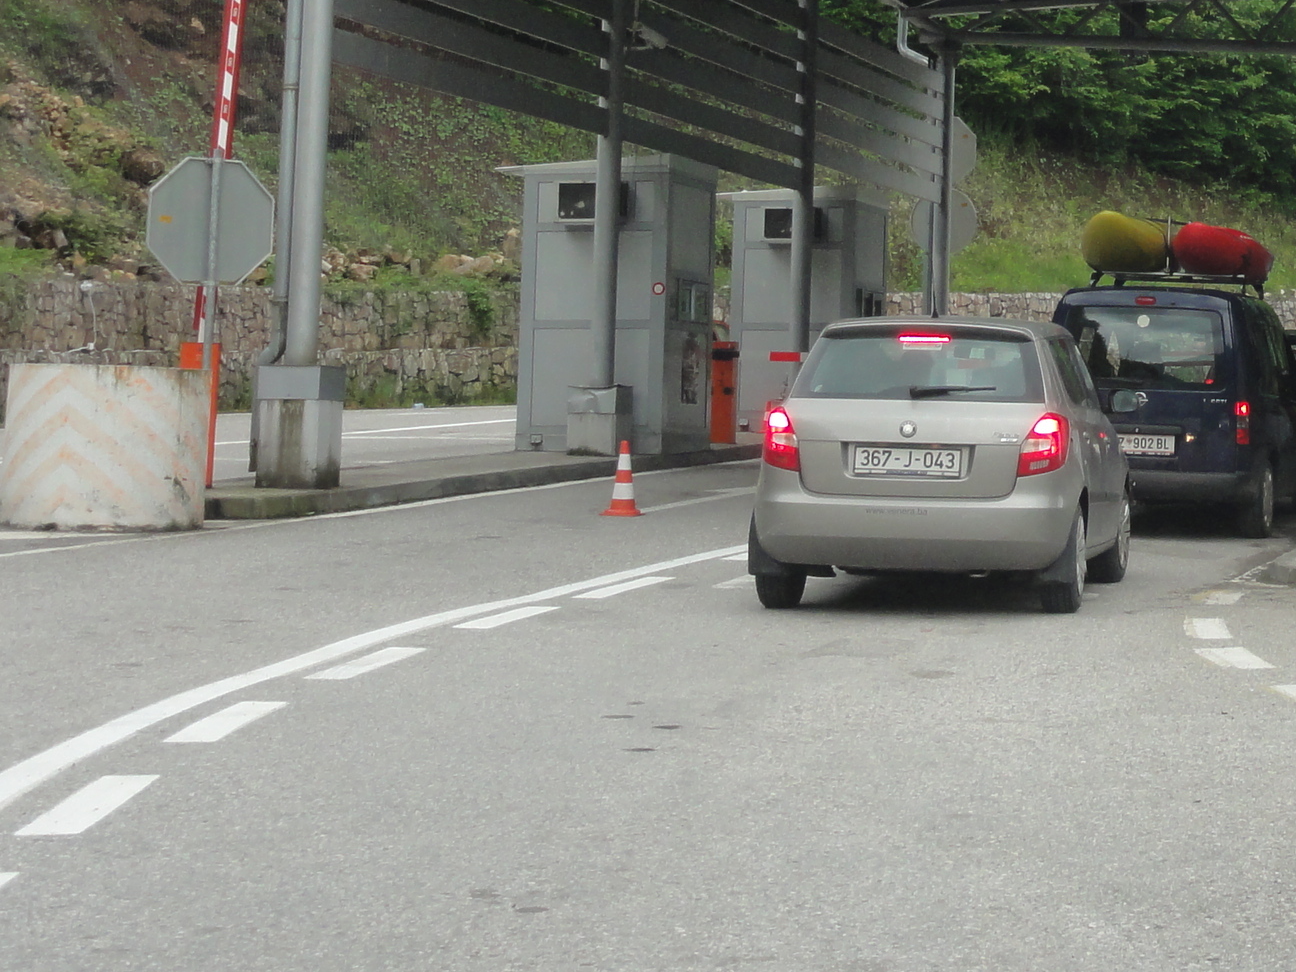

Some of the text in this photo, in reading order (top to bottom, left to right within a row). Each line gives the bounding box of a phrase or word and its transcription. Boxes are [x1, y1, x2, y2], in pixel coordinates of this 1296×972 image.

[1133, 437, 1154, 449] 902
[1156, 438, 1169, 449] BL
[860, 449, 955, 469] 367-J-043
